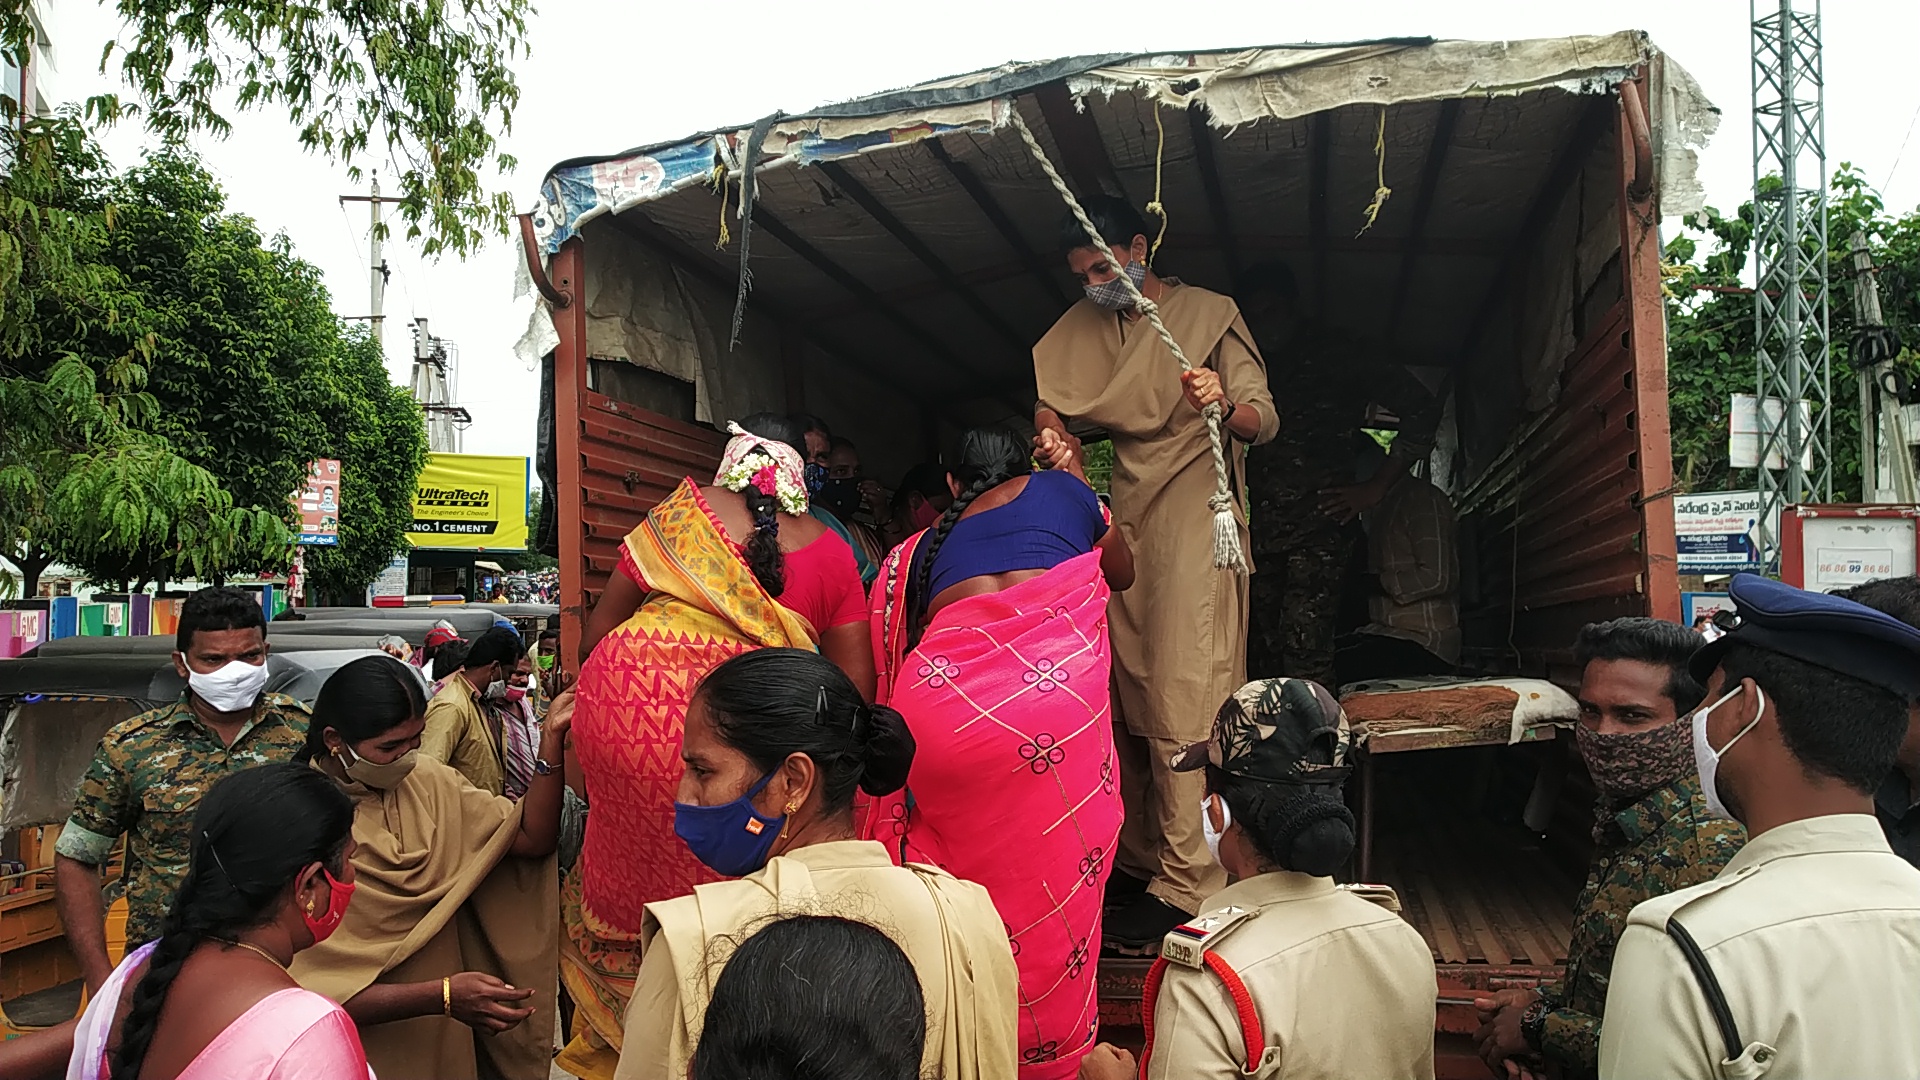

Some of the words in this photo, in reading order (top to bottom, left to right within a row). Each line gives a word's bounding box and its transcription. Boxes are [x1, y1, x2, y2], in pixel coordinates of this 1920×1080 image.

[418, 488, 489, 501] UltraTech
[1677, 501, 1709, 515] నరేంద్ర
[413, 521, 440, 532] NO.1
[442, 524, 488, 533] CEMENT
[1848, 564, 1862, 573] 99
[109, 605, 121, 624] GMC
[21, 616, 38, 638] GMC
